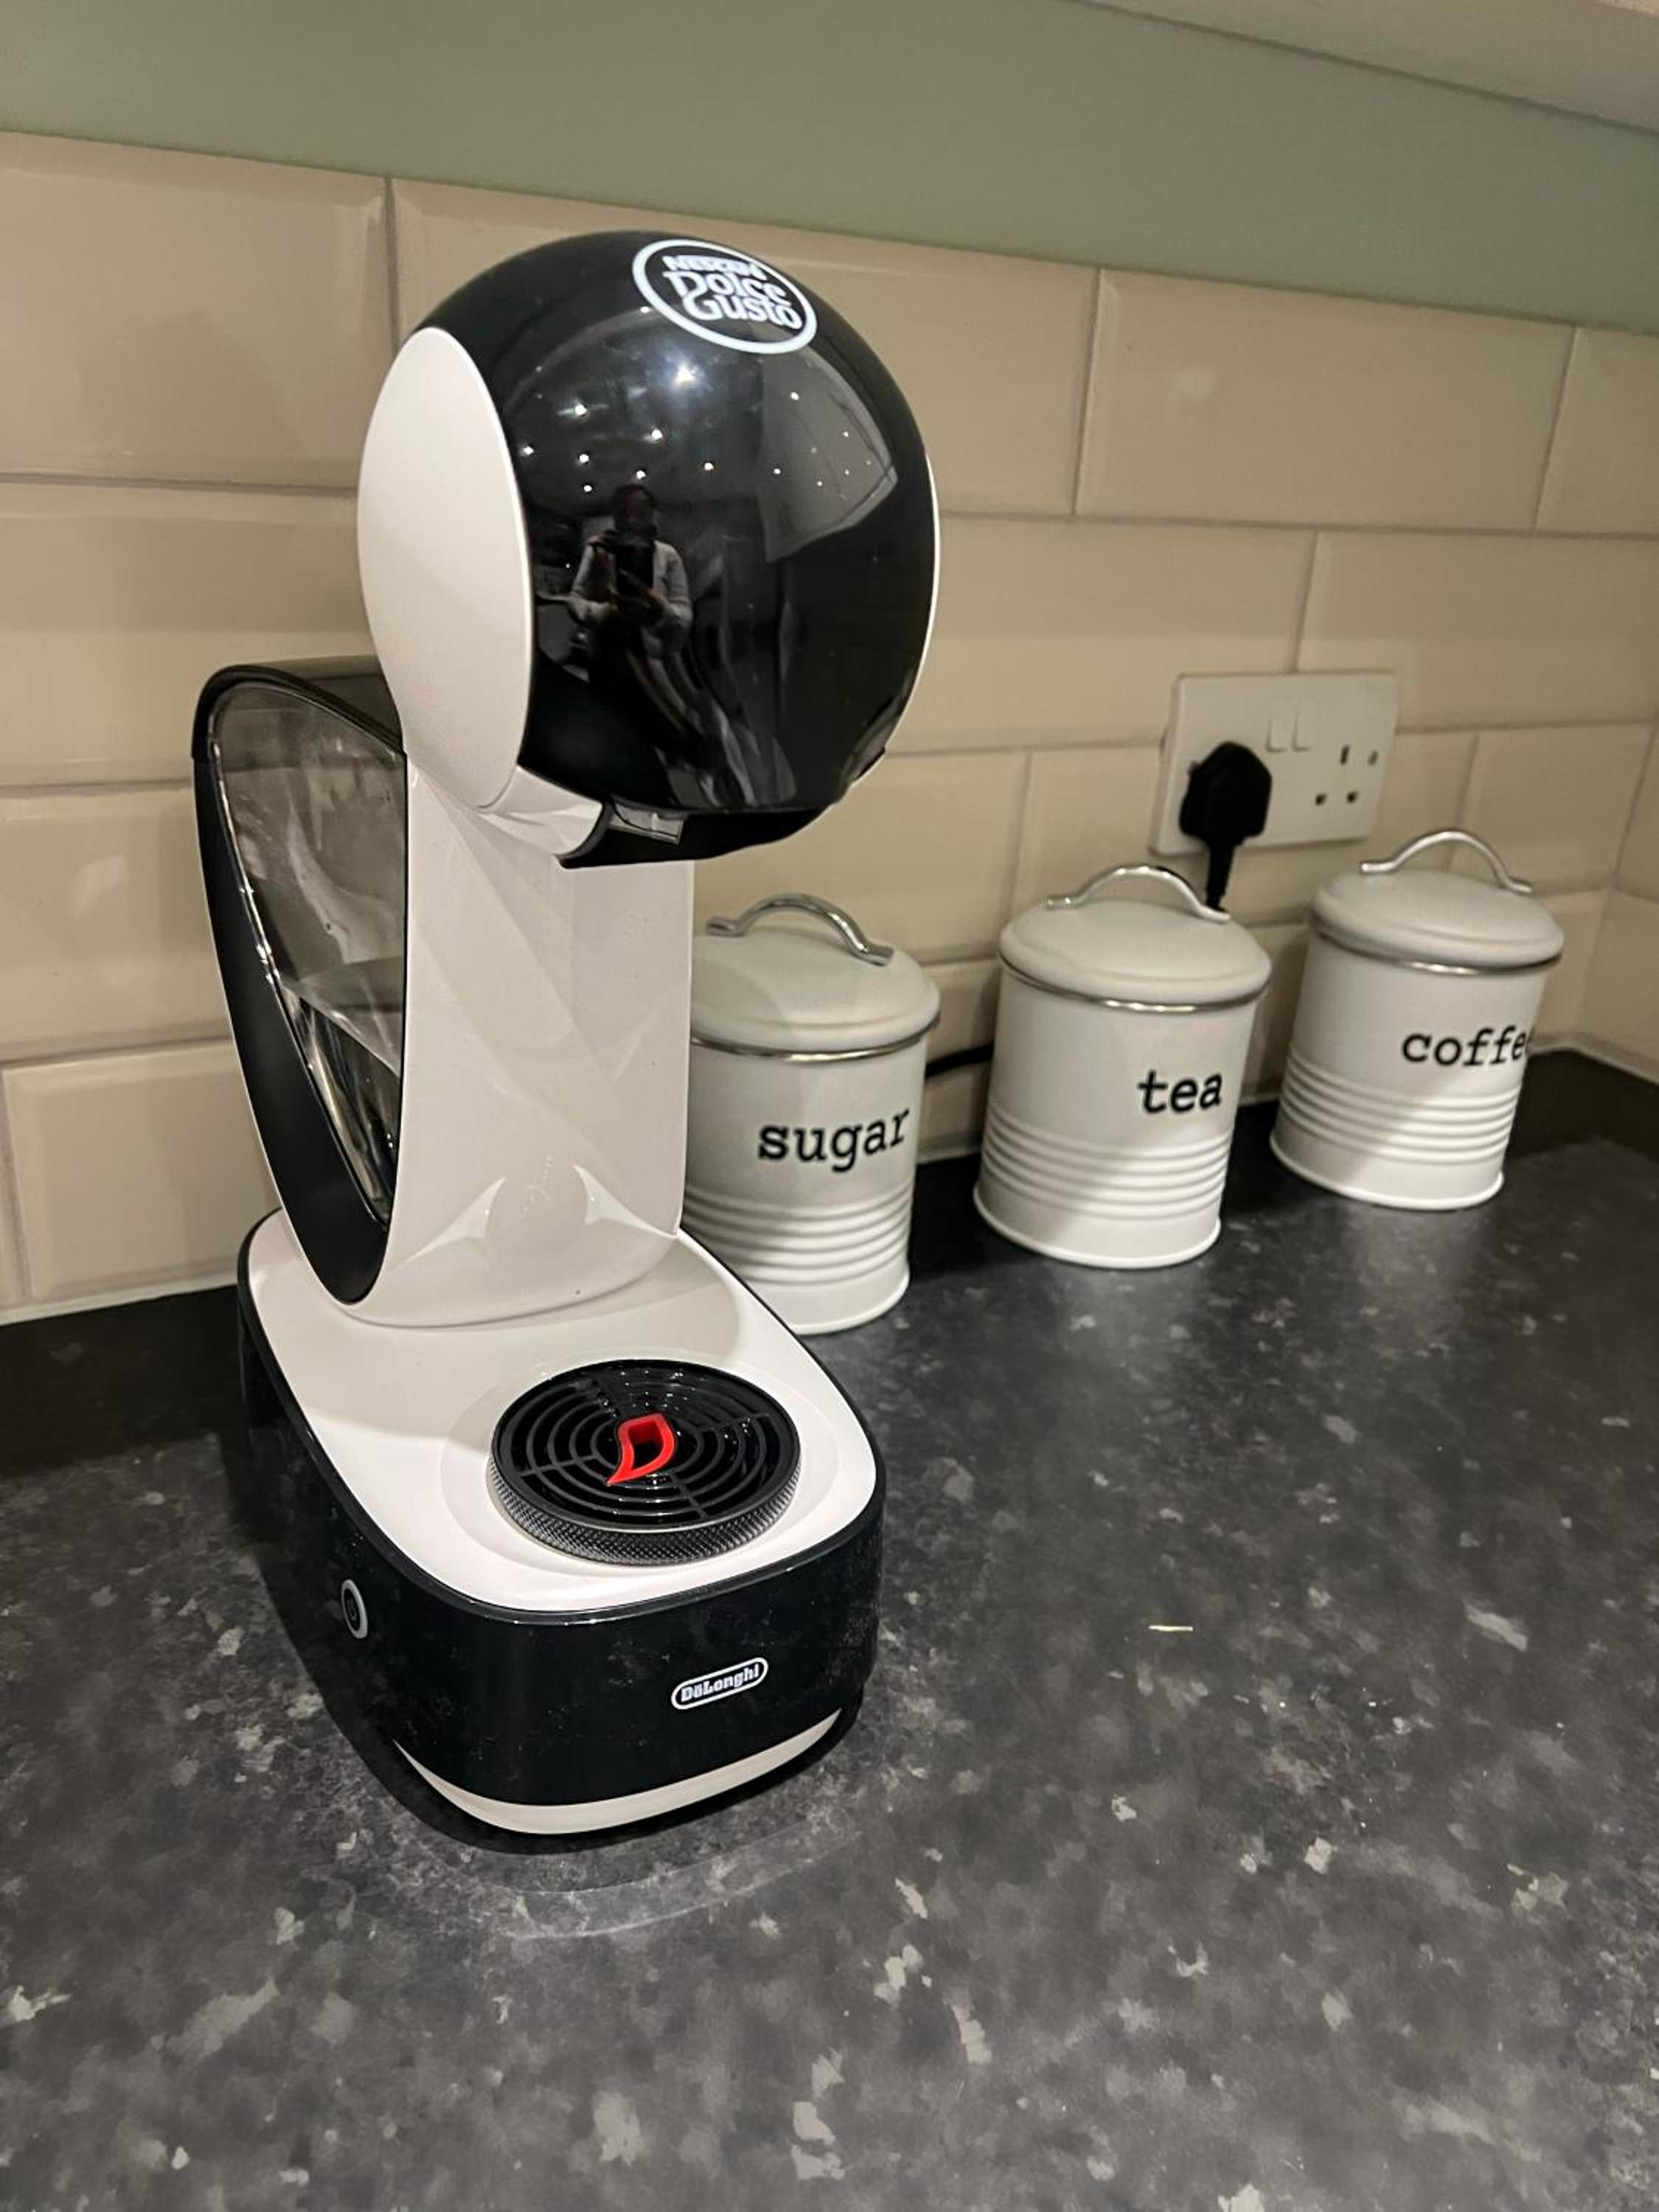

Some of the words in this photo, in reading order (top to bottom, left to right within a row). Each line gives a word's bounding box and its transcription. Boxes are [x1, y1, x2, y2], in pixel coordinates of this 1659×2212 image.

[663, 271, 791, 306] Dolce
[682, 293, 803, 330] Gusto
[1402, 1025, 1531, 1066] coffe
[1138, 1069, 1222, 1113] tea
[758, 1107, 910, 1172] sugar
